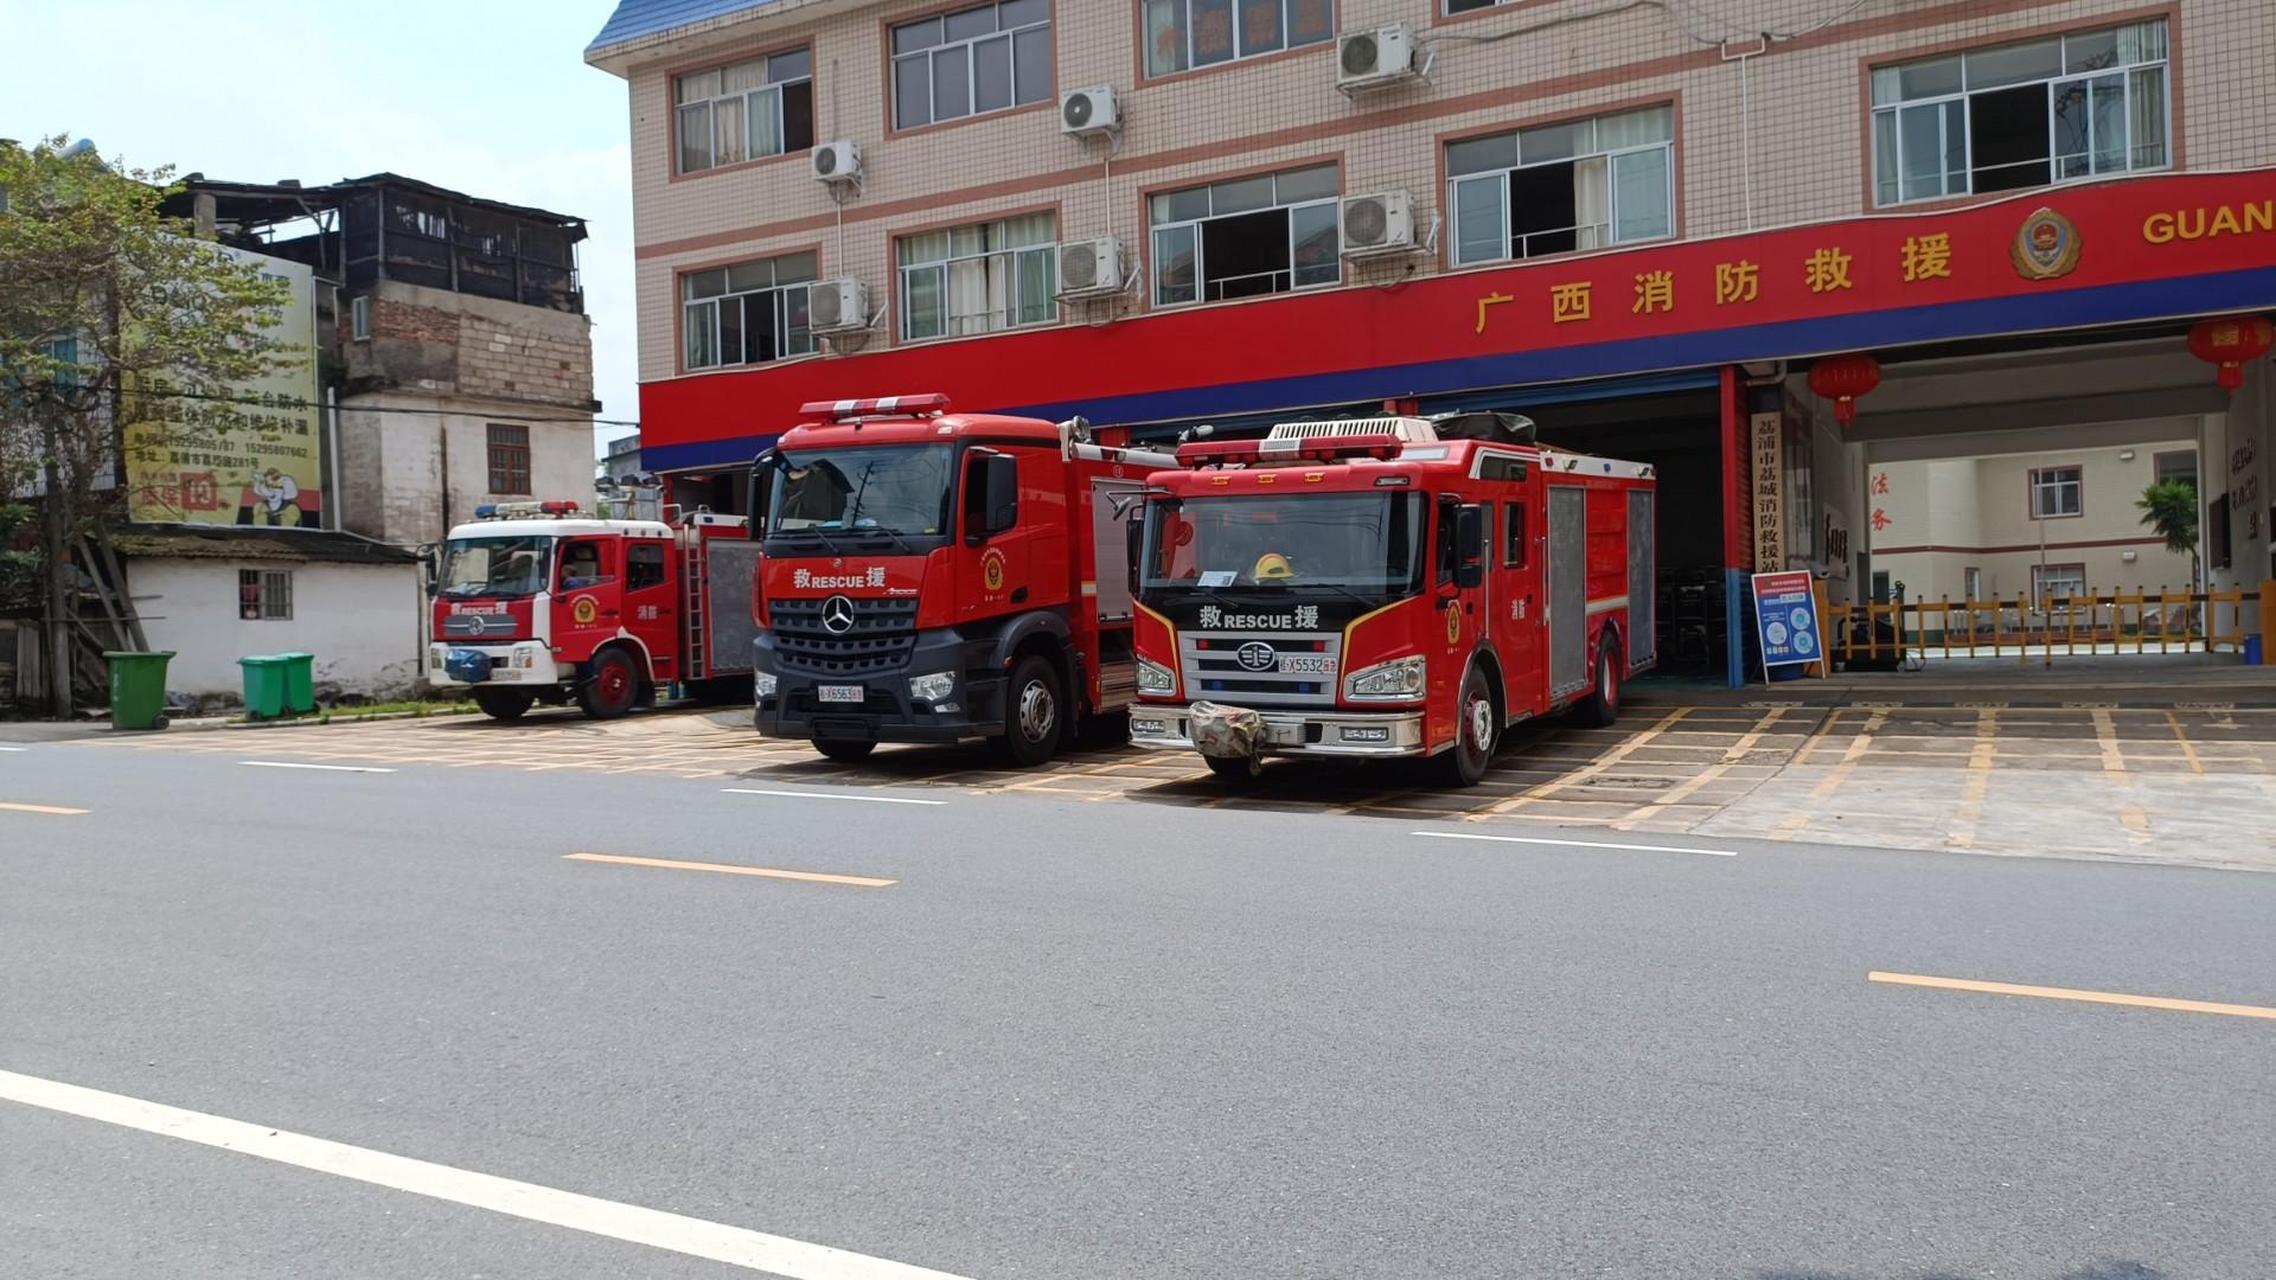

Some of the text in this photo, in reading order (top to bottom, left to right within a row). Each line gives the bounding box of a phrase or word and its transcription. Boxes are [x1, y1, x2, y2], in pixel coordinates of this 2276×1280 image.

[2143, 200, 2273, 243] GUAN
[1475, 232, 1952, 334] 广西消防救援
[812, 576, 864, 588] RESCUE
[1224, 614, 1292, 629] RESCUE
